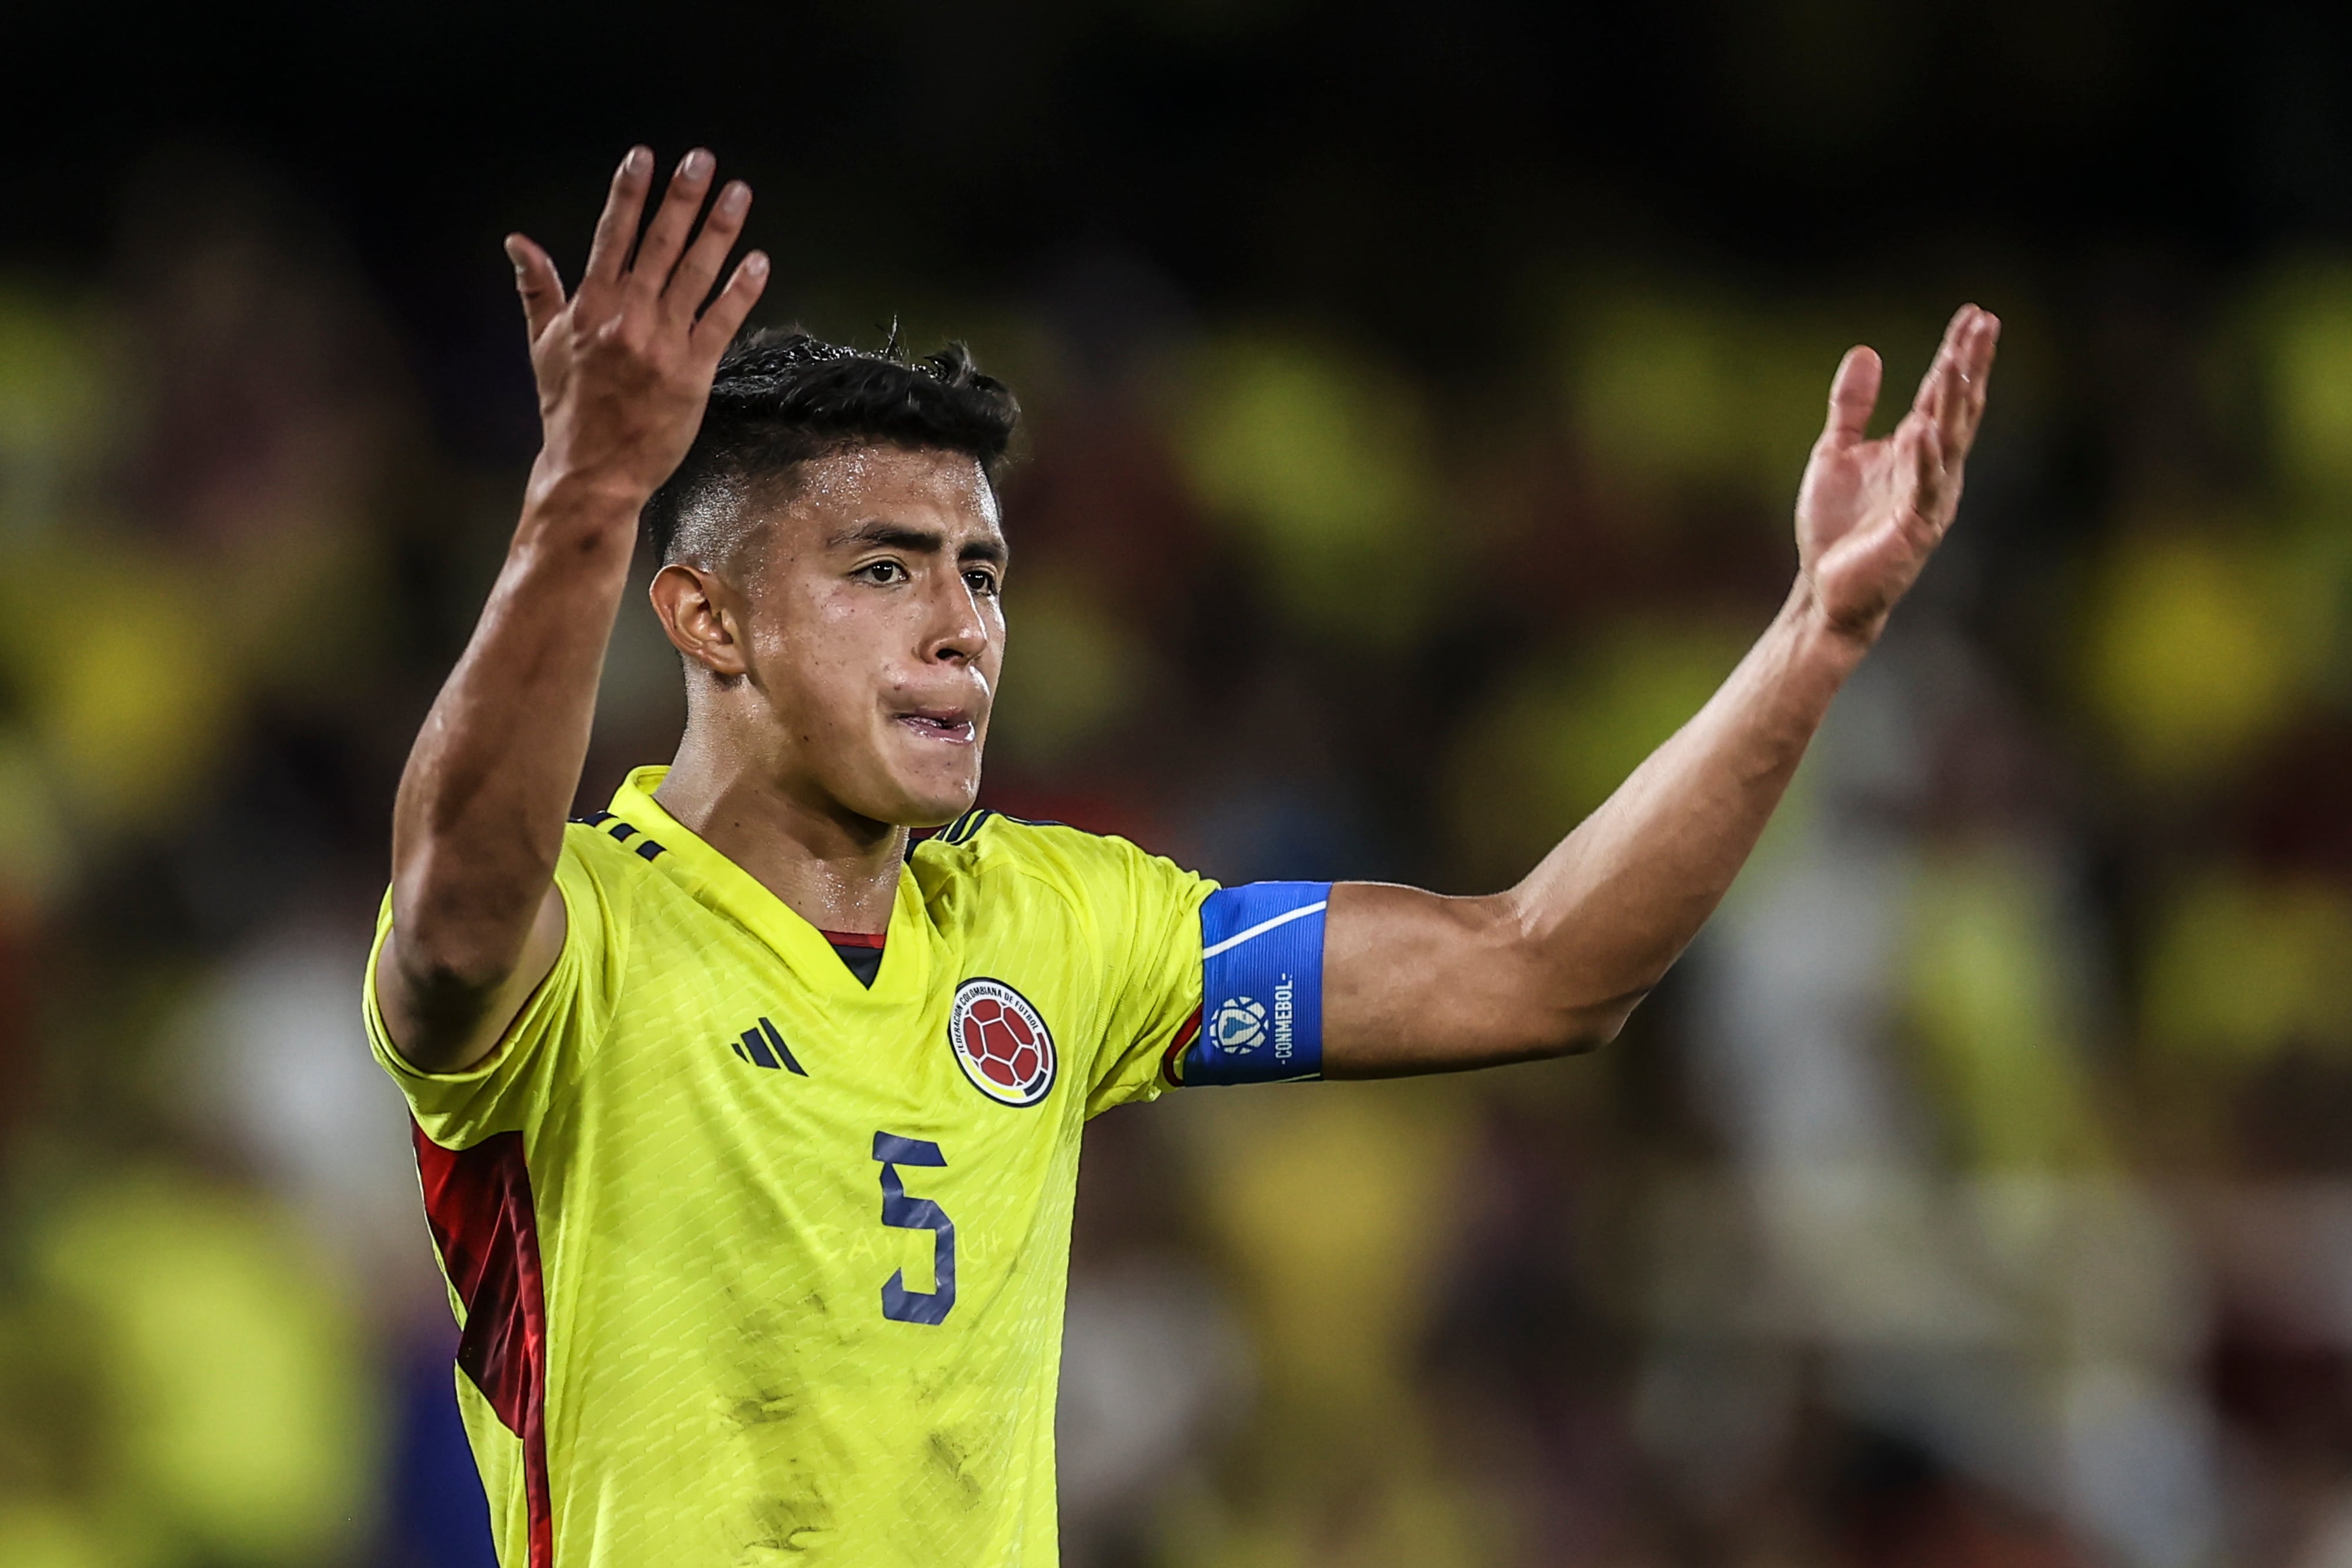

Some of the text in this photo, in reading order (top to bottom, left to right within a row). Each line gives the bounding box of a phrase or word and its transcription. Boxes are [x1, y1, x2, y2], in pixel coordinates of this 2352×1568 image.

[959, 987, 1001, 1005] COLOMBIANA
[1004, 992, 1013, 1004] DE
[1015, 1001, 1038, 1030] FUTBOL
[872, 1131, 956, 1326] 5
